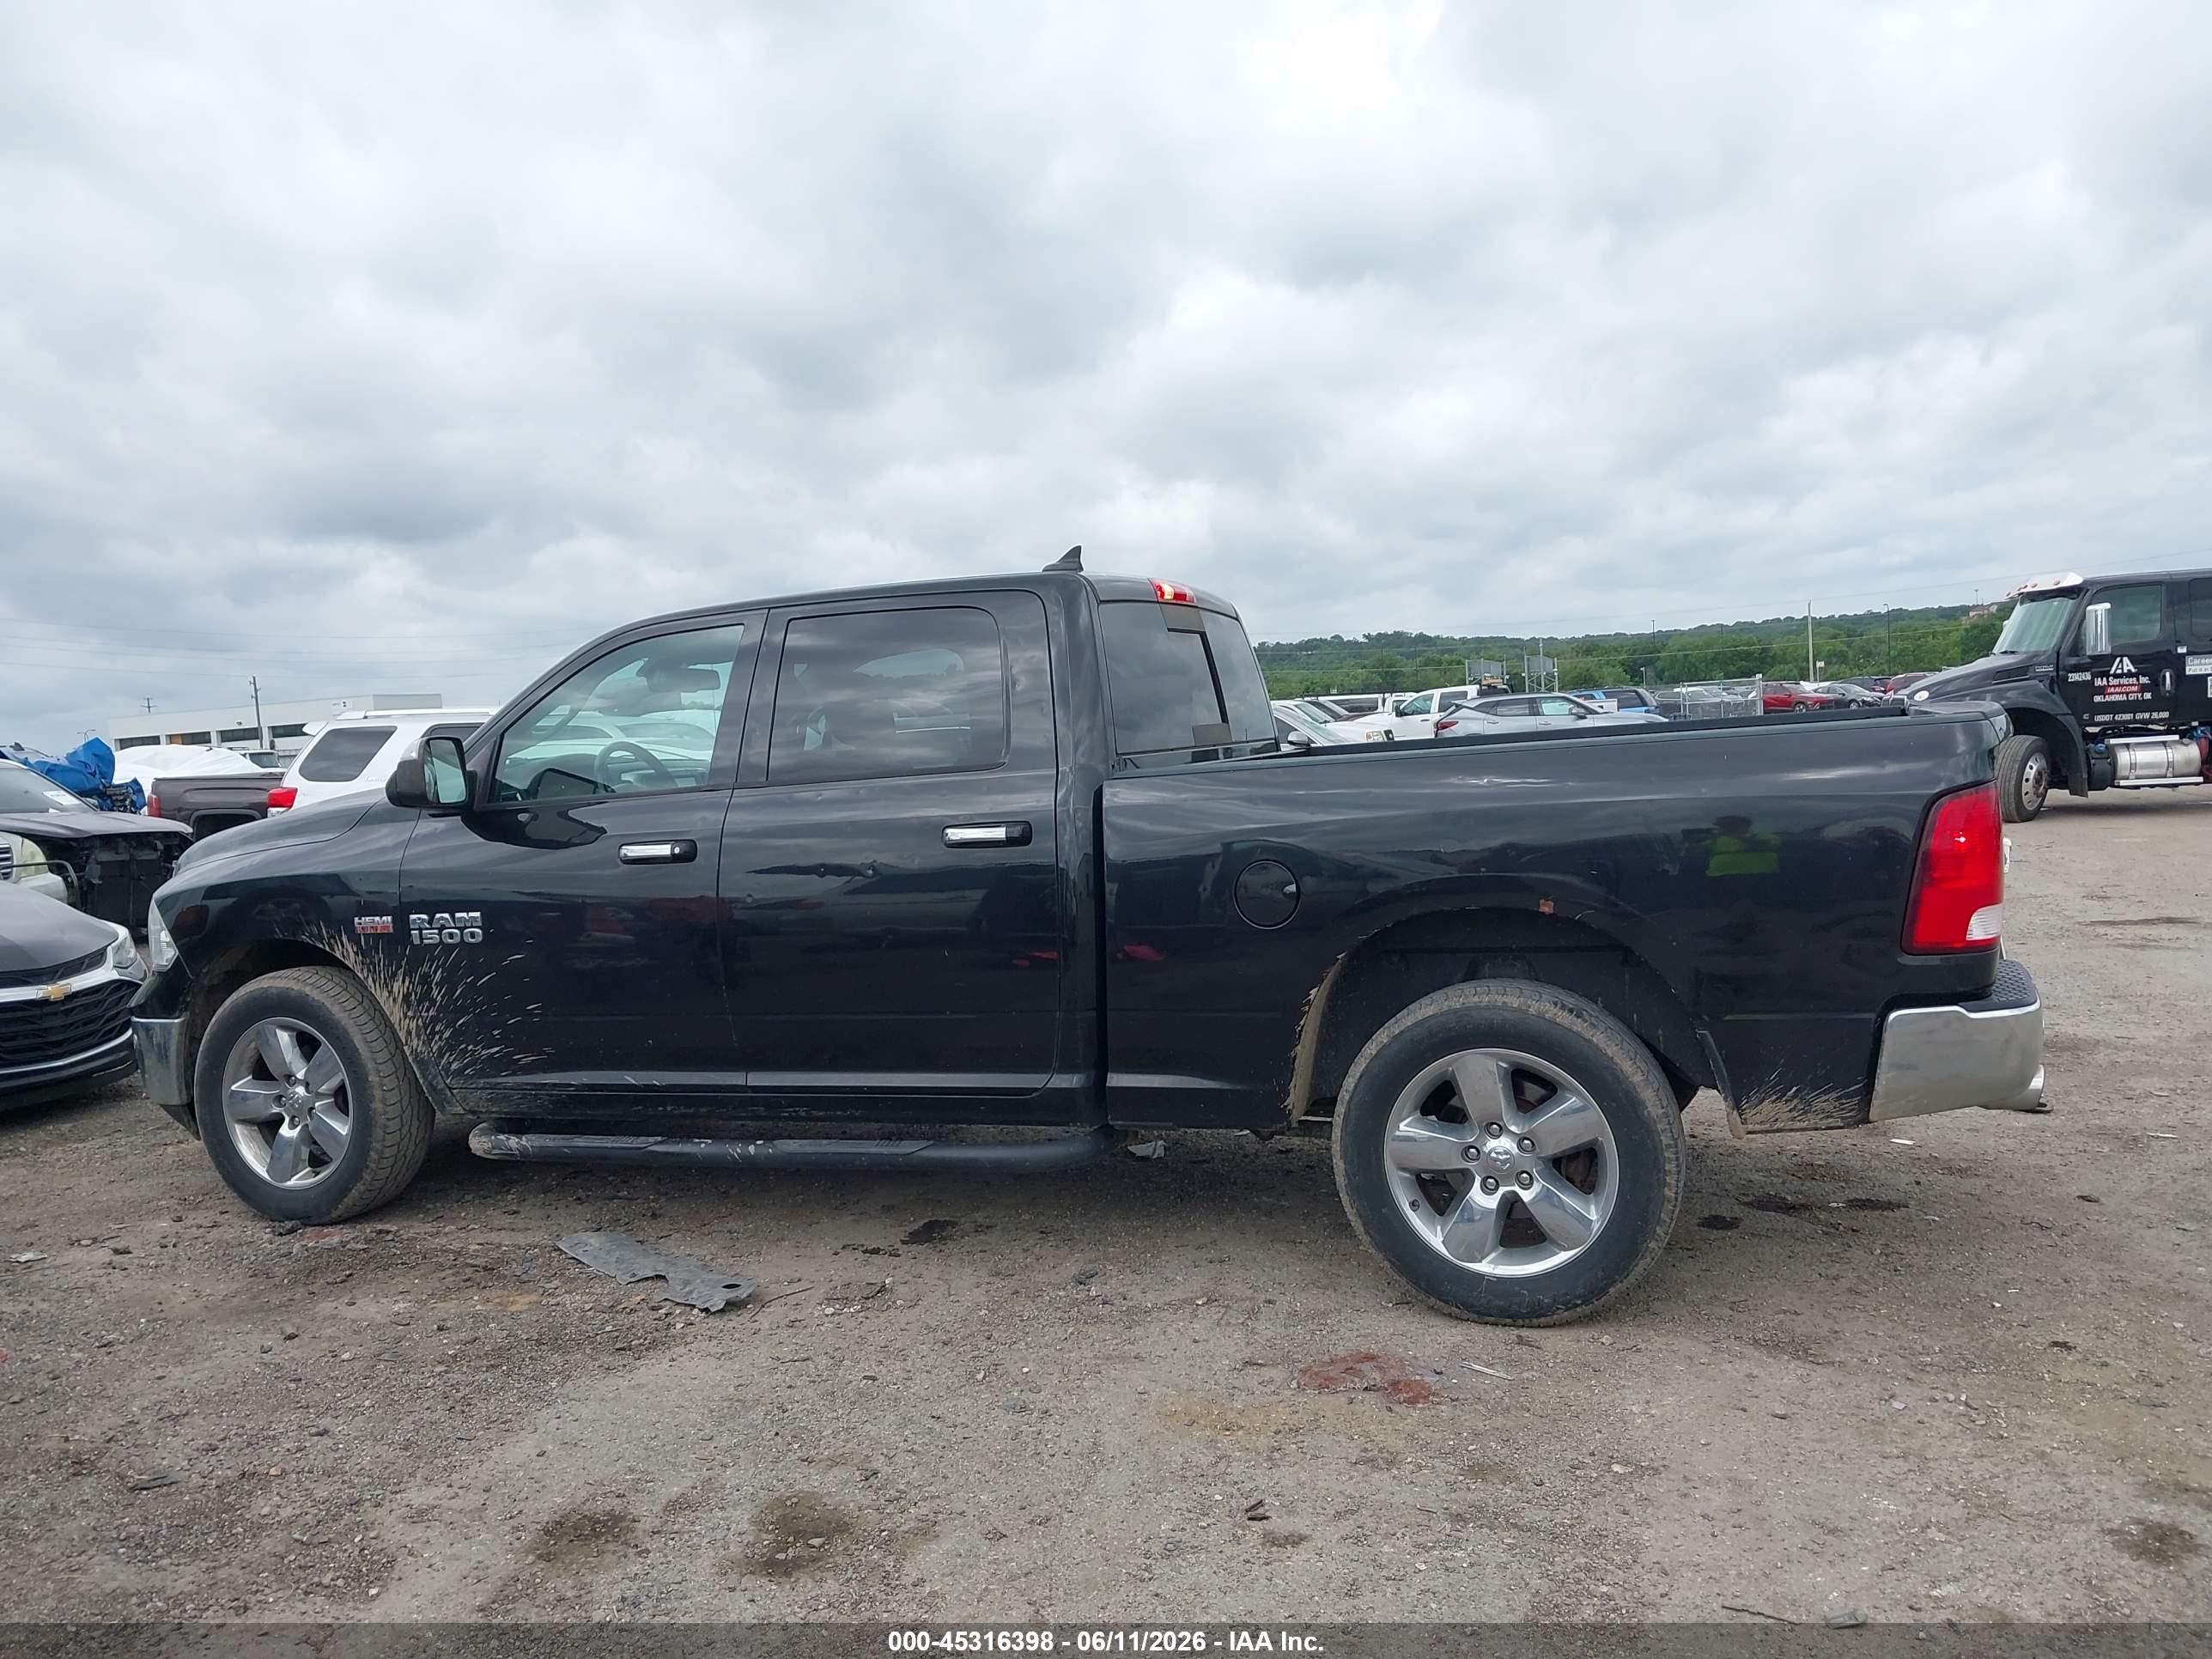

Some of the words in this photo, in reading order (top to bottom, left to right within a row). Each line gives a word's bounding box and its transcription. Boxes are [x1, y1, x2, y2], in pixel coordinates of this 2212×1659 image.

[2094, 677, 2107, 686] IAA
[2139, 674, 2151, 684] Inc.
[2094, 693, 2127, 702] OKLAHOMA
[2143, 691, 2153, 700] OK
[2094, 714, 2114, 722] USDOT
[2135, 711, 2151, 720] GVW
[354, 915, 392, 927] HEMI
[409, 911, 482, 929] RAM
[410, 927, 483, 945] 1500
